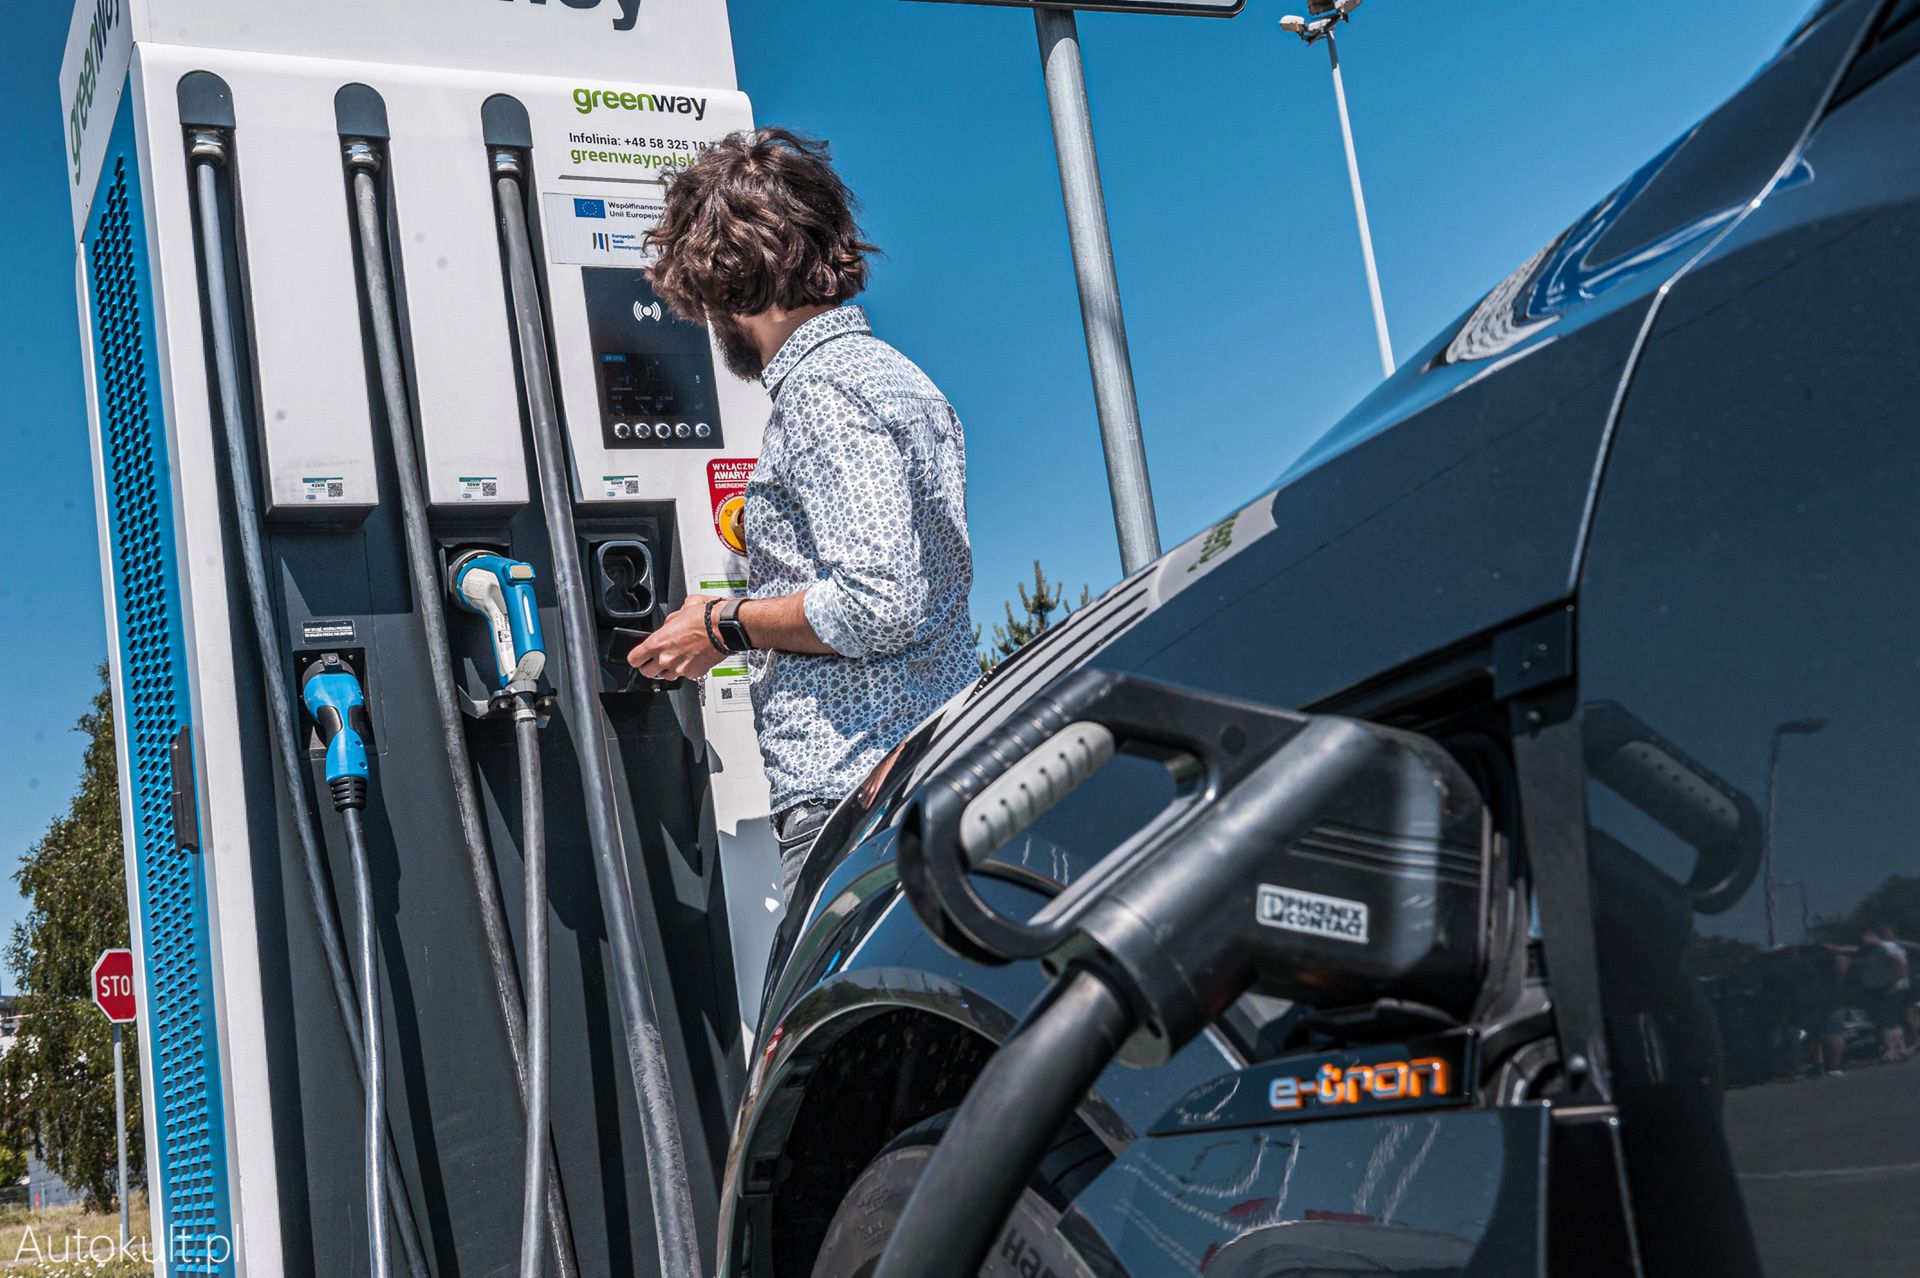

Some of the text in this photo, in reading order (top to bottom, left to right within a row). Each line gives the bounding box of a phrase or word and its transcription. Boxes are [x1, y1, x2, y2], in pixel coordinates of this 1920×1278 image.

[573, 88, 707, 121] greenway
[569, 132, 622, 146] Infolinia:
[624, 137, 646, 148] +48
[650, 138, 664, 149] 58
[667, 139, 689, 150] 325
[714, 471, 753, 480] AWARYJ
[1287, 911, 1361, 936] CONTACT
[100, 975, 134, 997] STO
[1269, 1056, 1447, 1110] e-tron
[1001, 1227, 1058, 1278] Ha
